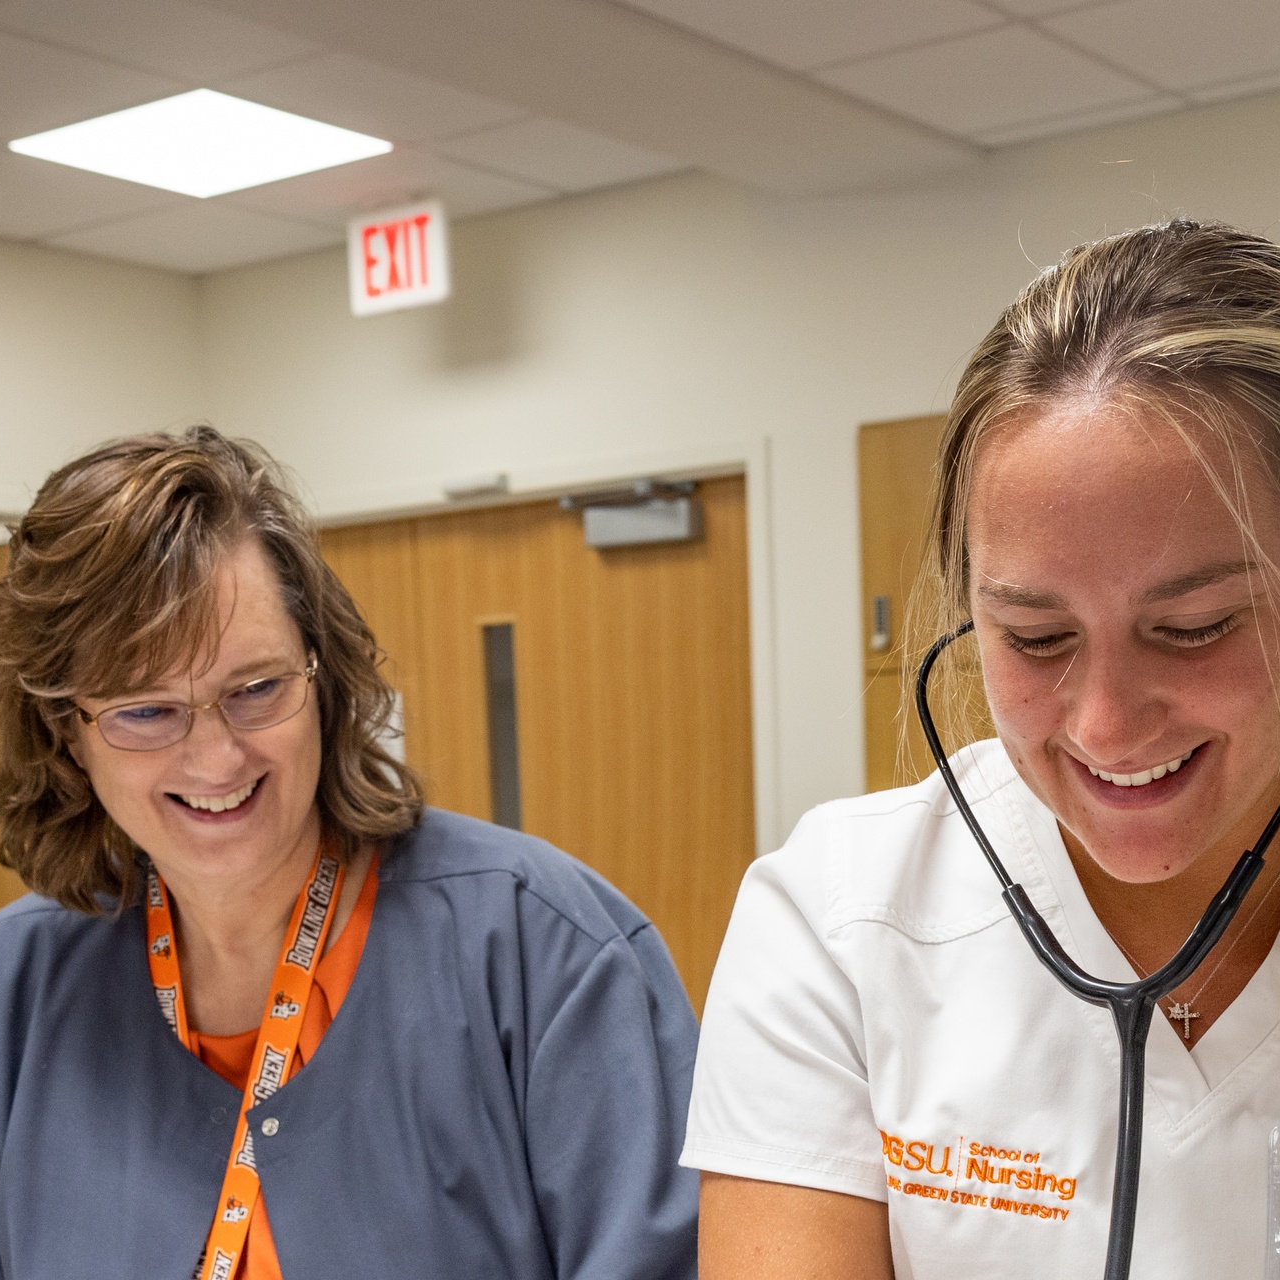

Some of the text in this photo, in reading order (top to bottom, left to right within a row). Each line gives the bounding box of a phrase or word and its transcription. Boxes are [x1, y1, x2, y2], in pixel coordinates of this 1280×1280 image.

[361, 213, 430, 298] EXIT
[286, 900, 327, 970] BOWLING
[969, 1142, 1040, 1164] School of
[965, 1157, 1077, 1200] Nursing
[903, 1183, 1070, 1221] GREEN STATE UNIVERSITY
